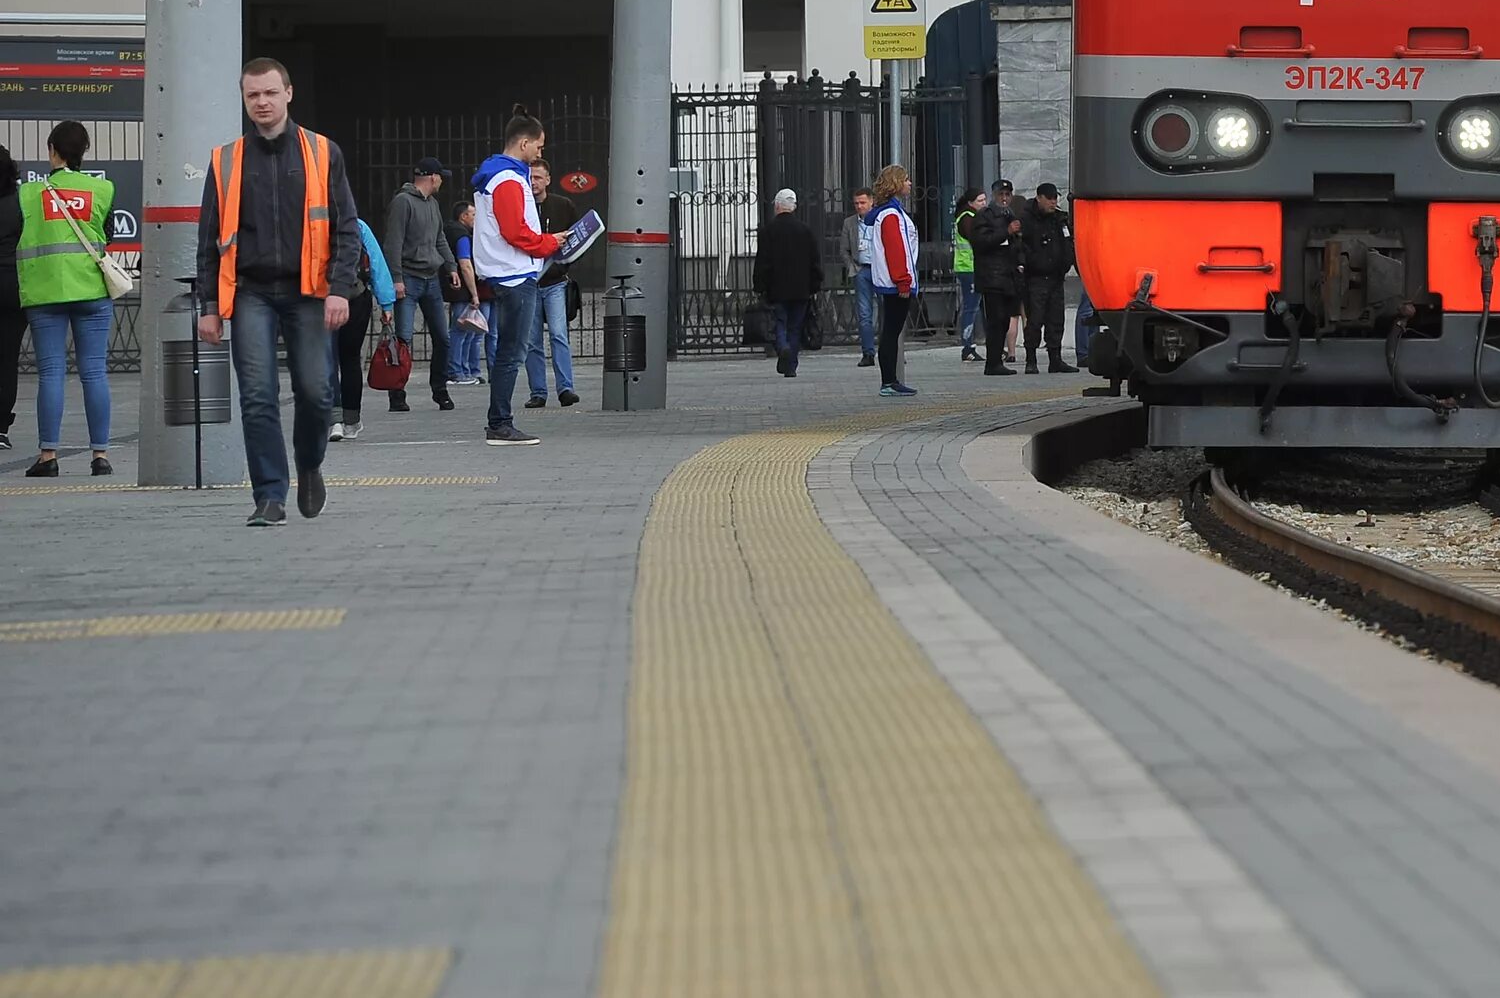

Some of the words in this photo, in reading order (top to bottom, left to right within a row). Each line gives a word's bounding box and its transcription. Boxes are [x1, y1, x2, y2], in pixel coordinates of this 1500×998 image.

[56, 48, 94, 56] Московское
[119, 51, 145, 61] 07:5
[1285, 66, 1425, 90] ЭП2К-347
[0, 83, 24, 93] ЗАНЬ
[42, 83, 114, 94] ЕКАТЕРИНБУРГ
